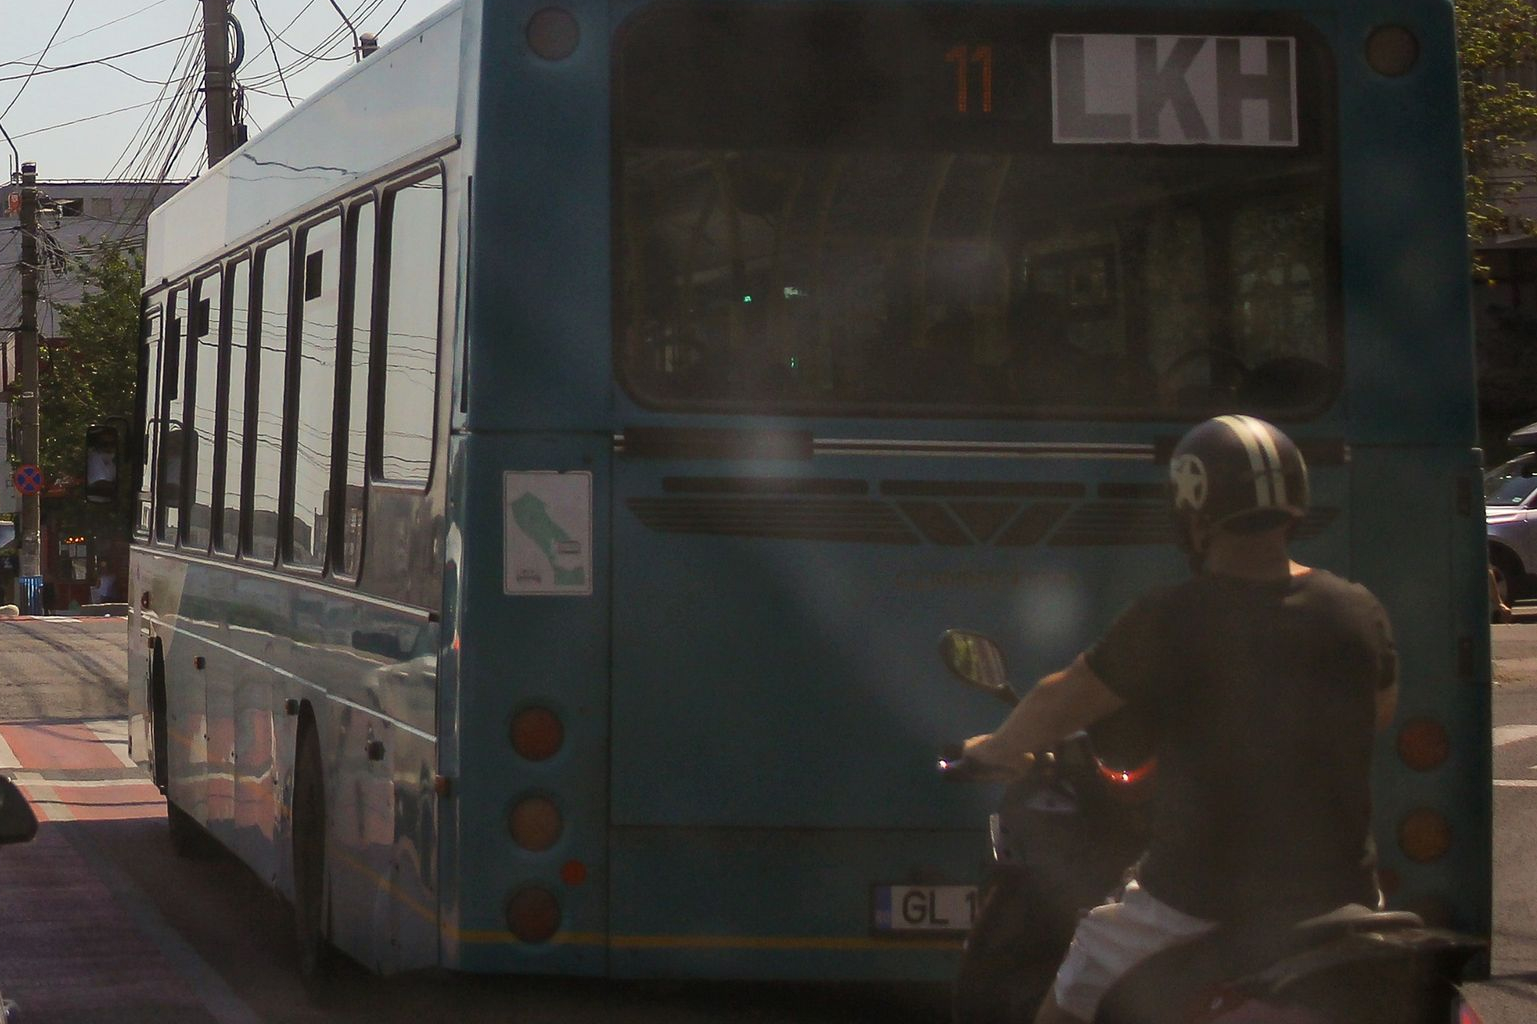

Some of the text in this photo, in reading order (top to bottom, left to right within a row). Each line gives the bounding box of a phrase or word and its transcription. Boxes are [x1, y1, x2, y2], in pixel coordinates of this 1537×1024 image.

[944, 36, 1293, 142] 11 LKH
[902, 890, 950, 925] GL
